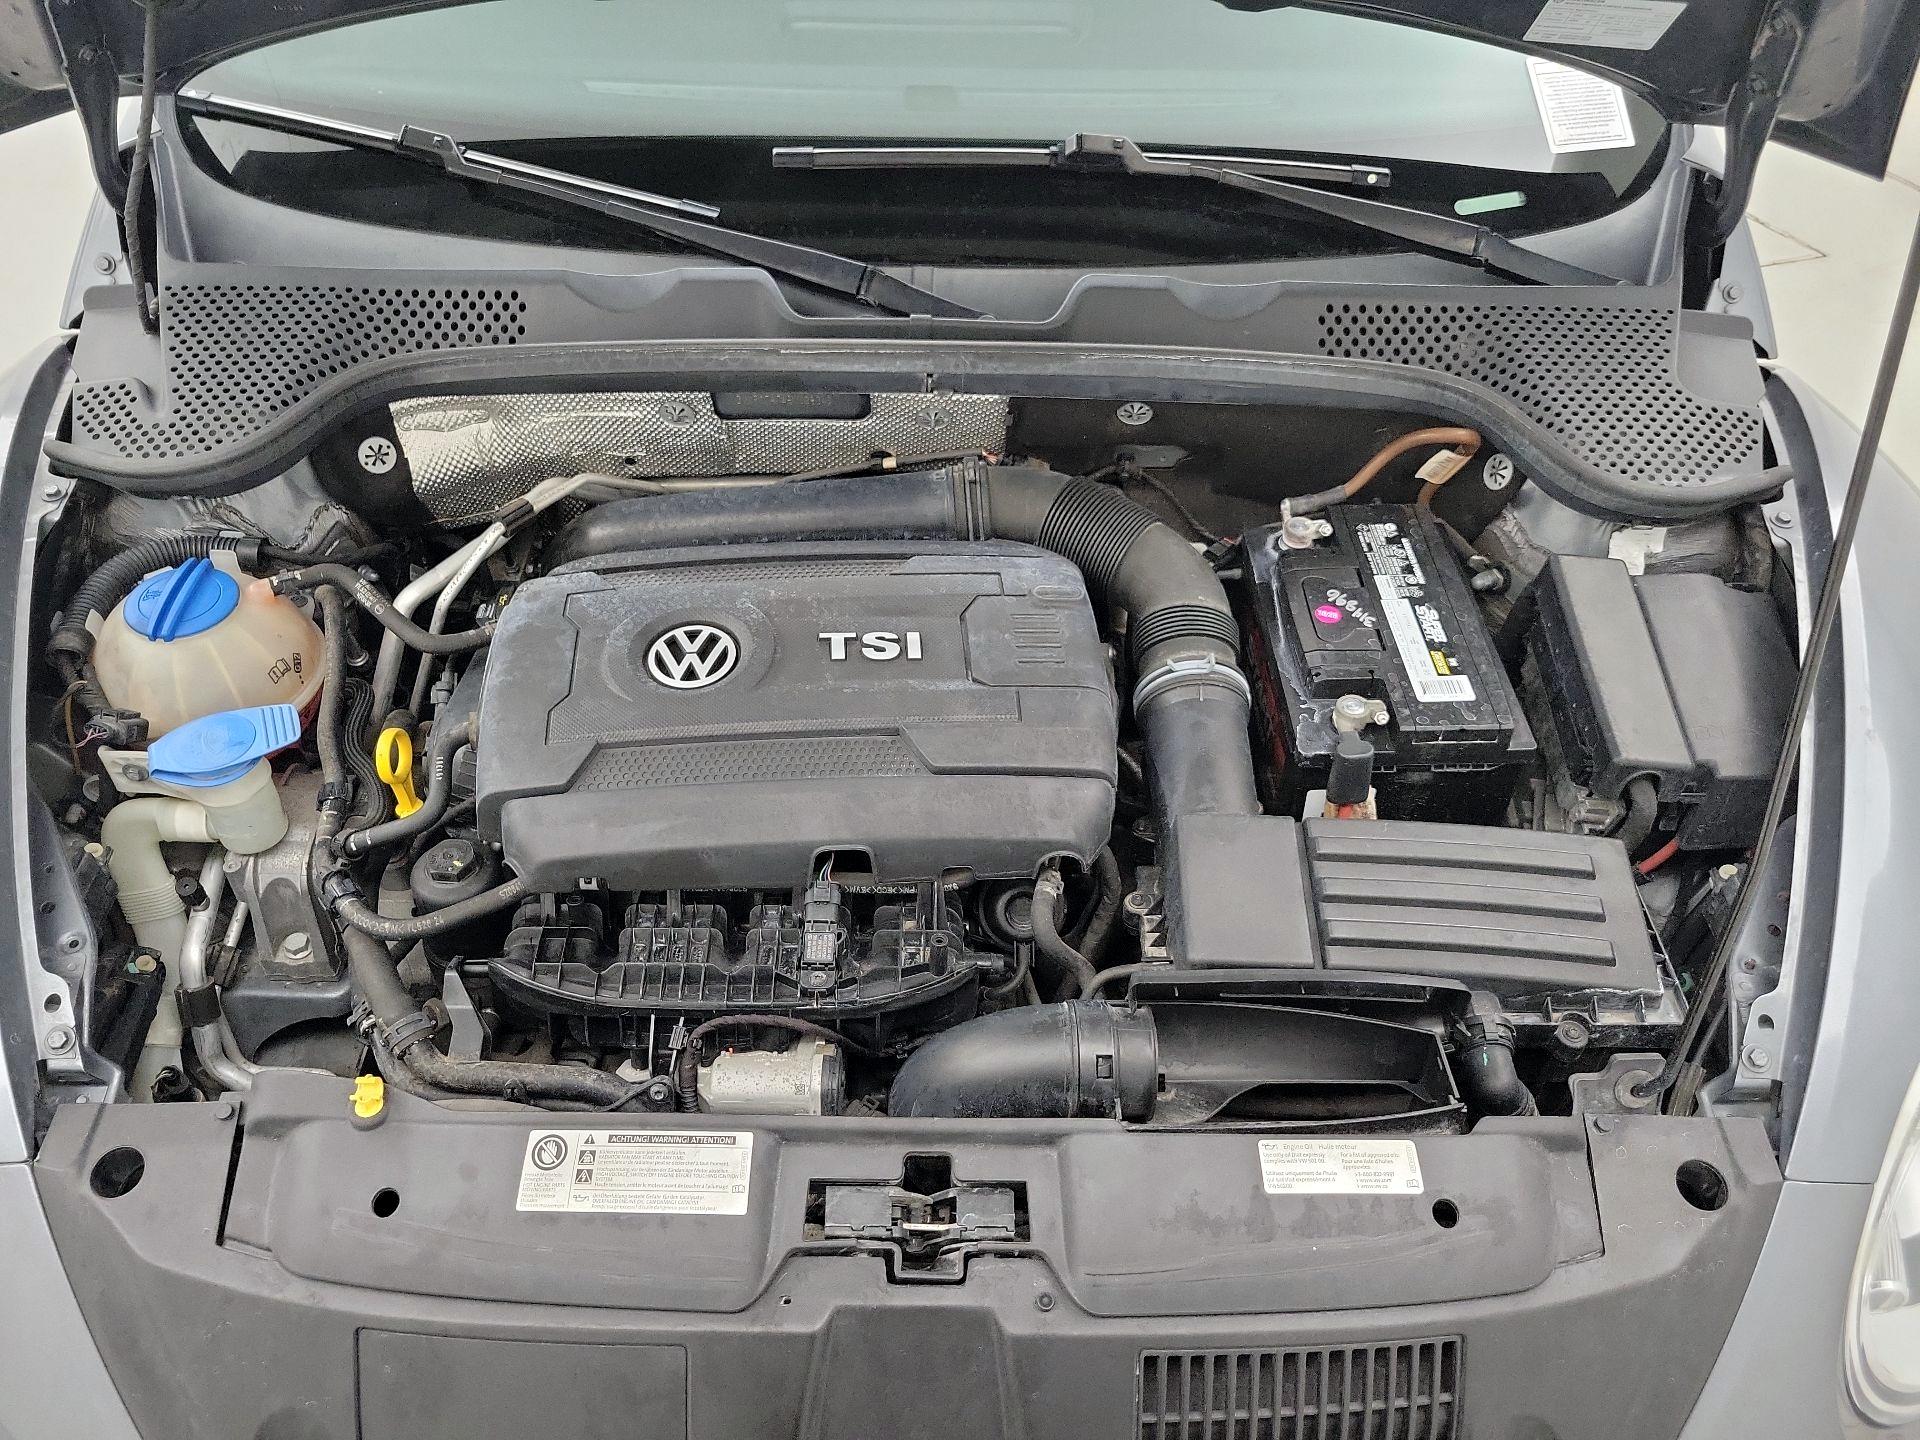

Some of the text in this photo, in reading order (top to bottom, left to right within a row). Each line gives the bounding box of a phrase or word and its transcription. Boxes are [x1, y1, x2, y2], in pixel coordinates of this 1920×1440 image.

[1414, 604, 1436, 642] START
[1426, 604, 1448, 643] SUPER
[818, 631, 923, 661] TSI
[610, 1135, 650, 1143] ACHTUNG!
[690, 1136, 734, 1144] ATTENTION!
